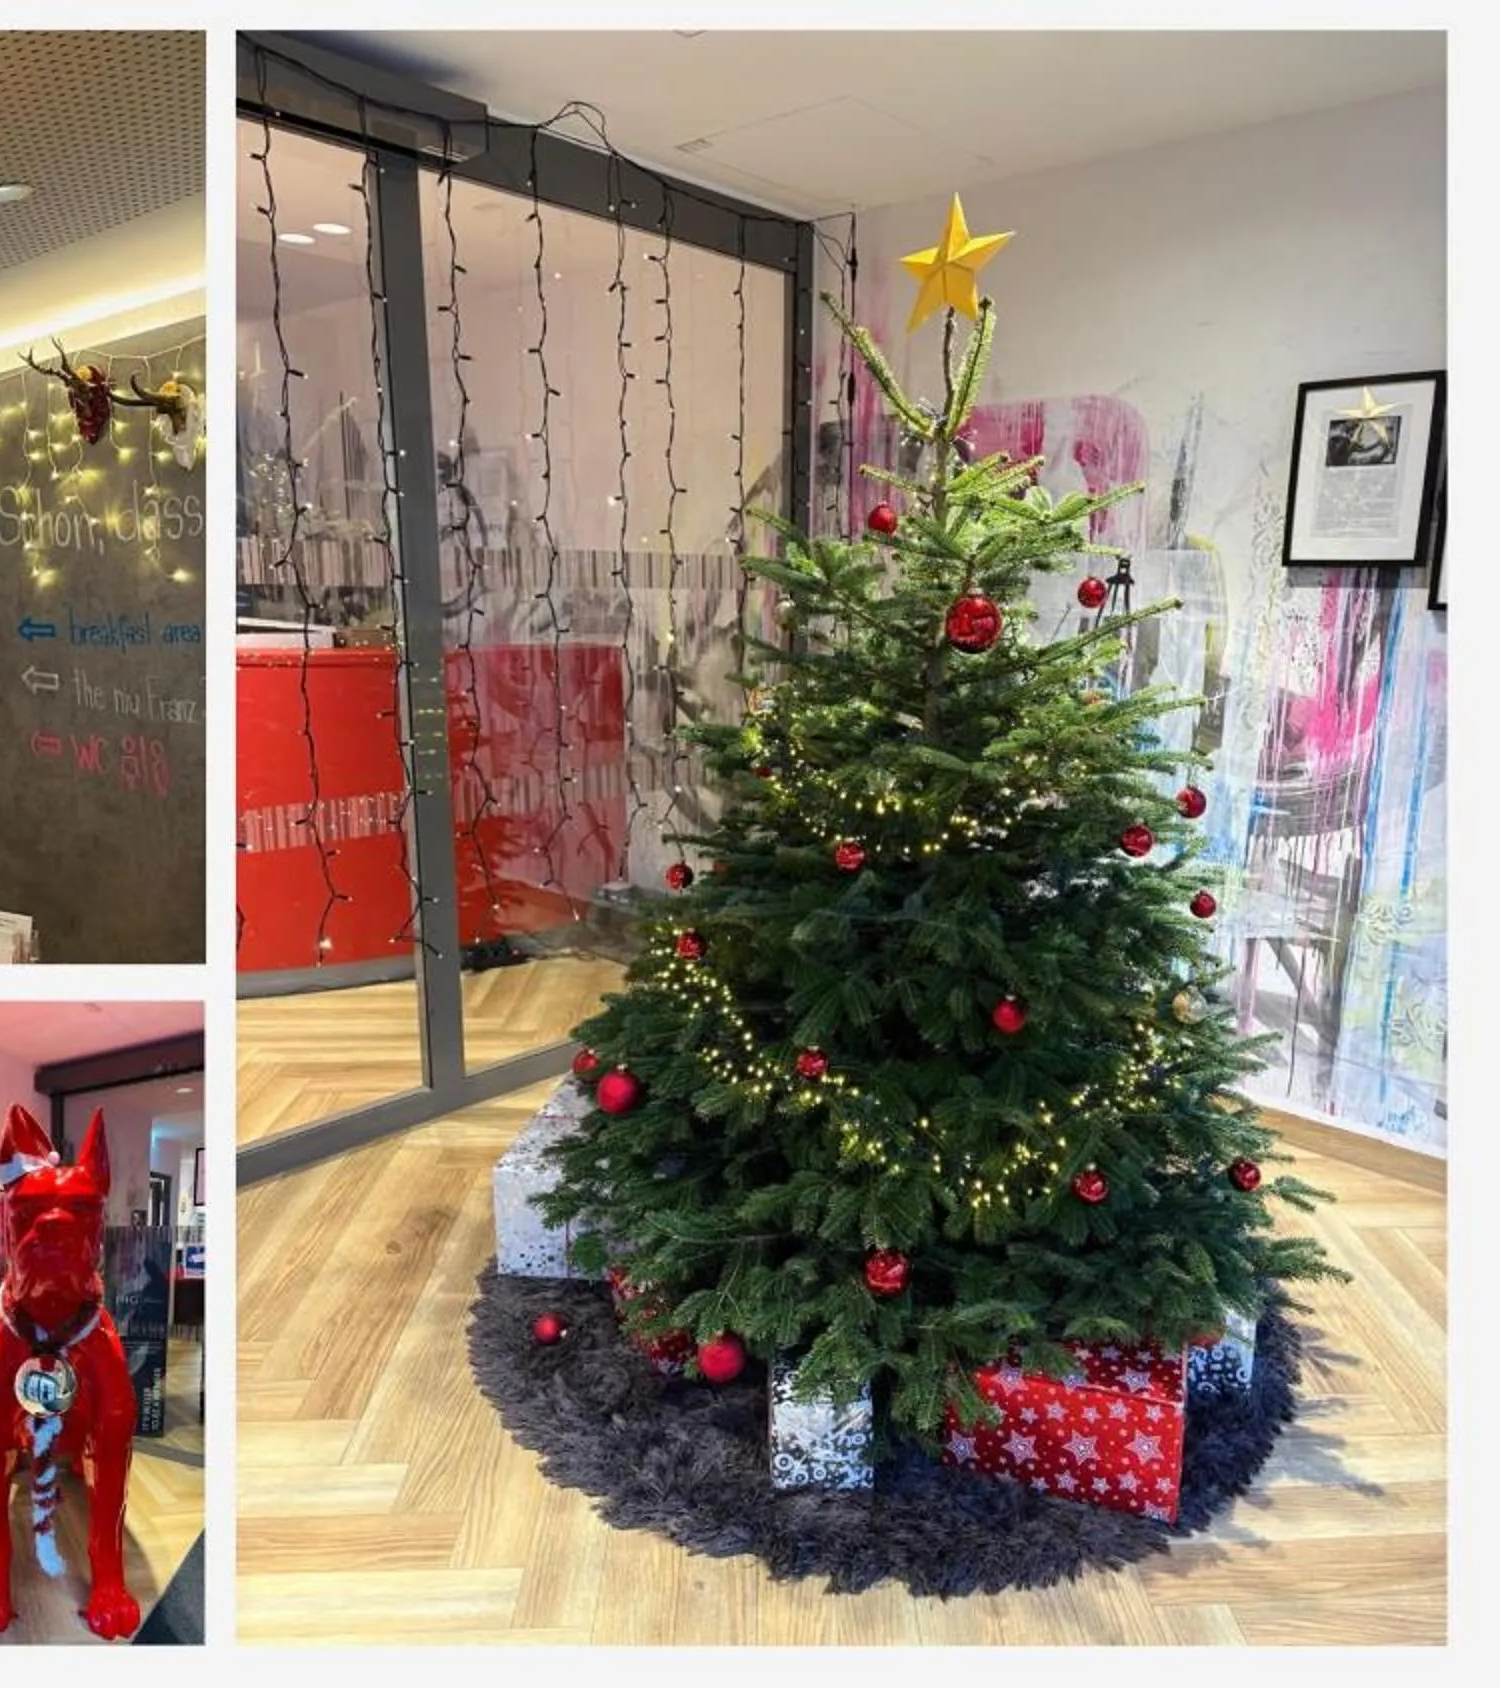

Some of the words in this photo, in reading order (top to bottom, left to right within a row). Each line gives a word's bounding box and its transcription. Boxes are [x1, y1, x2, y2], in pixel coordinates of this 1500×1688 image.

[70, 609, 150, 654] breakfast
[161, 623, 202, 643] area
[71, 668, 105, 710] the
[146, 676, 198, 723] Franz
[69, 733, 106, 773] WC
